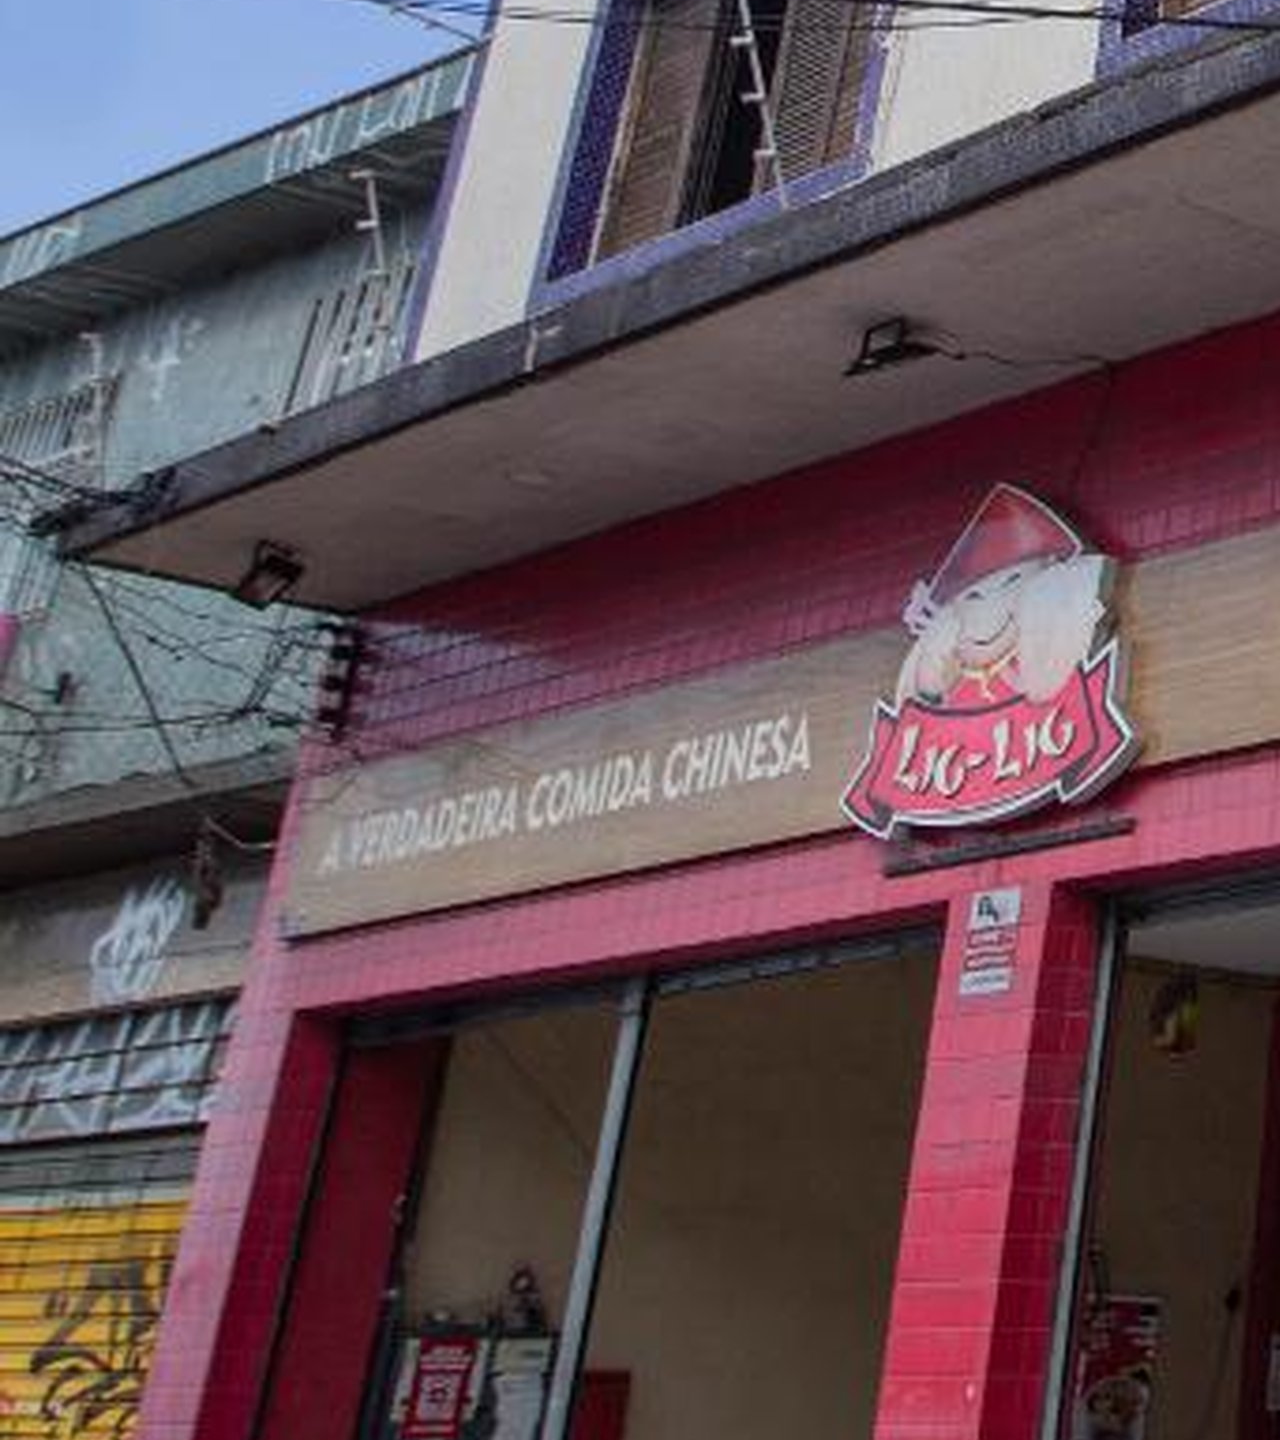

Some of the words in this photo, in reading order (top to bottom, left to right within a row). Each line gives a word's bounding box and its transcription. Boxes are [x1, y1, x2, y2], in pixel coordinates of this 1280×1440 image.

[316, 831, 344, 875] A
[348, 785, 519, 868] VERDADEIRA
[526, 750, 653, 830] COMIDA
[662, 716, 812, 800] CHINESA
